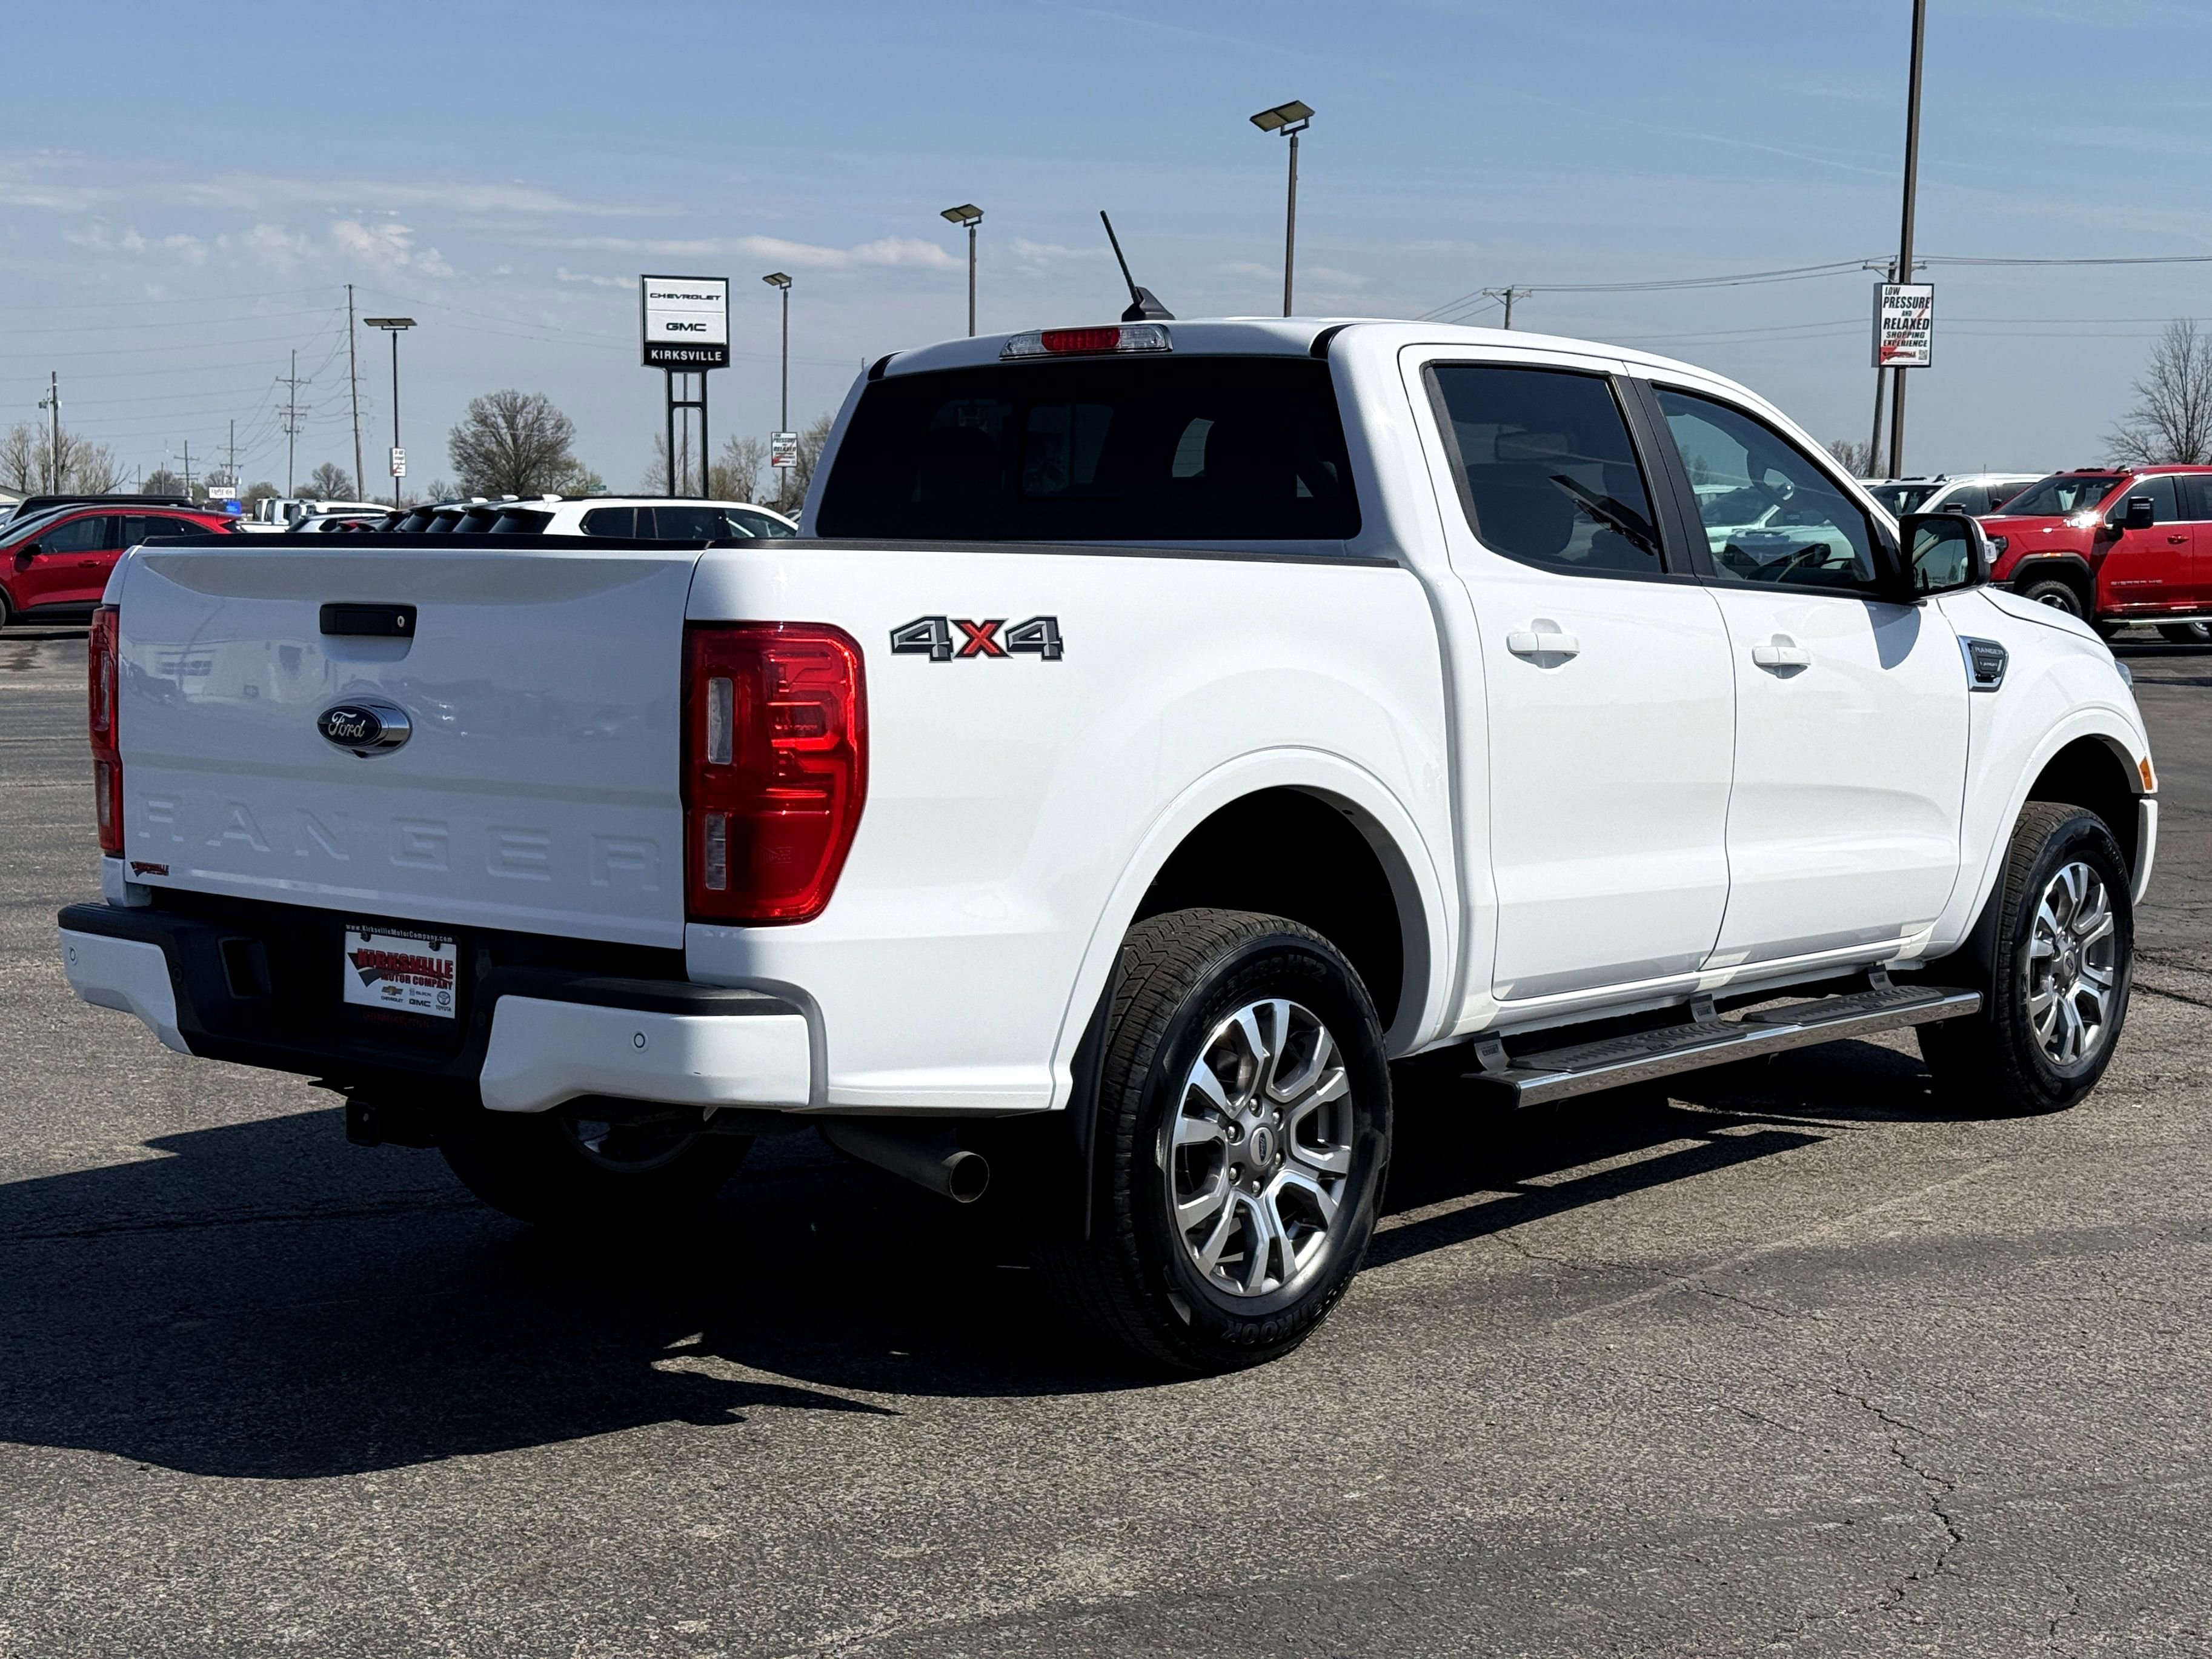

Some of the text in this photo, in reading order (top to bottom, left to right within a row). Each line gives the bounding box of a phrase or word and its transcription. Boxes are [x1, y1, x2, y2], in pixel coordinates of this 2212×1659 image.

[1885, 287, 1901, 295] LOW
[1883, 297, 1931, 309] PRESSURE
[666, 322, 706, 331] GMC
[1883, 318, 1930, 330] RELAXED
[651, 349, 722, 361] KIRKSVILLE
[1975, 647, 2004, 655] RANGER
[328, 711, 366, 738] Ford
[136, 790, 661, 893] RANGER
[345, 923, 453, 942] www.KirksvilleMotorCompany.com
[357, 948, 454, 979] KIRKSVILLE
[381, 972, 453, 991] MOTOR COMPANY
[409, 998, 431, 1007] GMC
